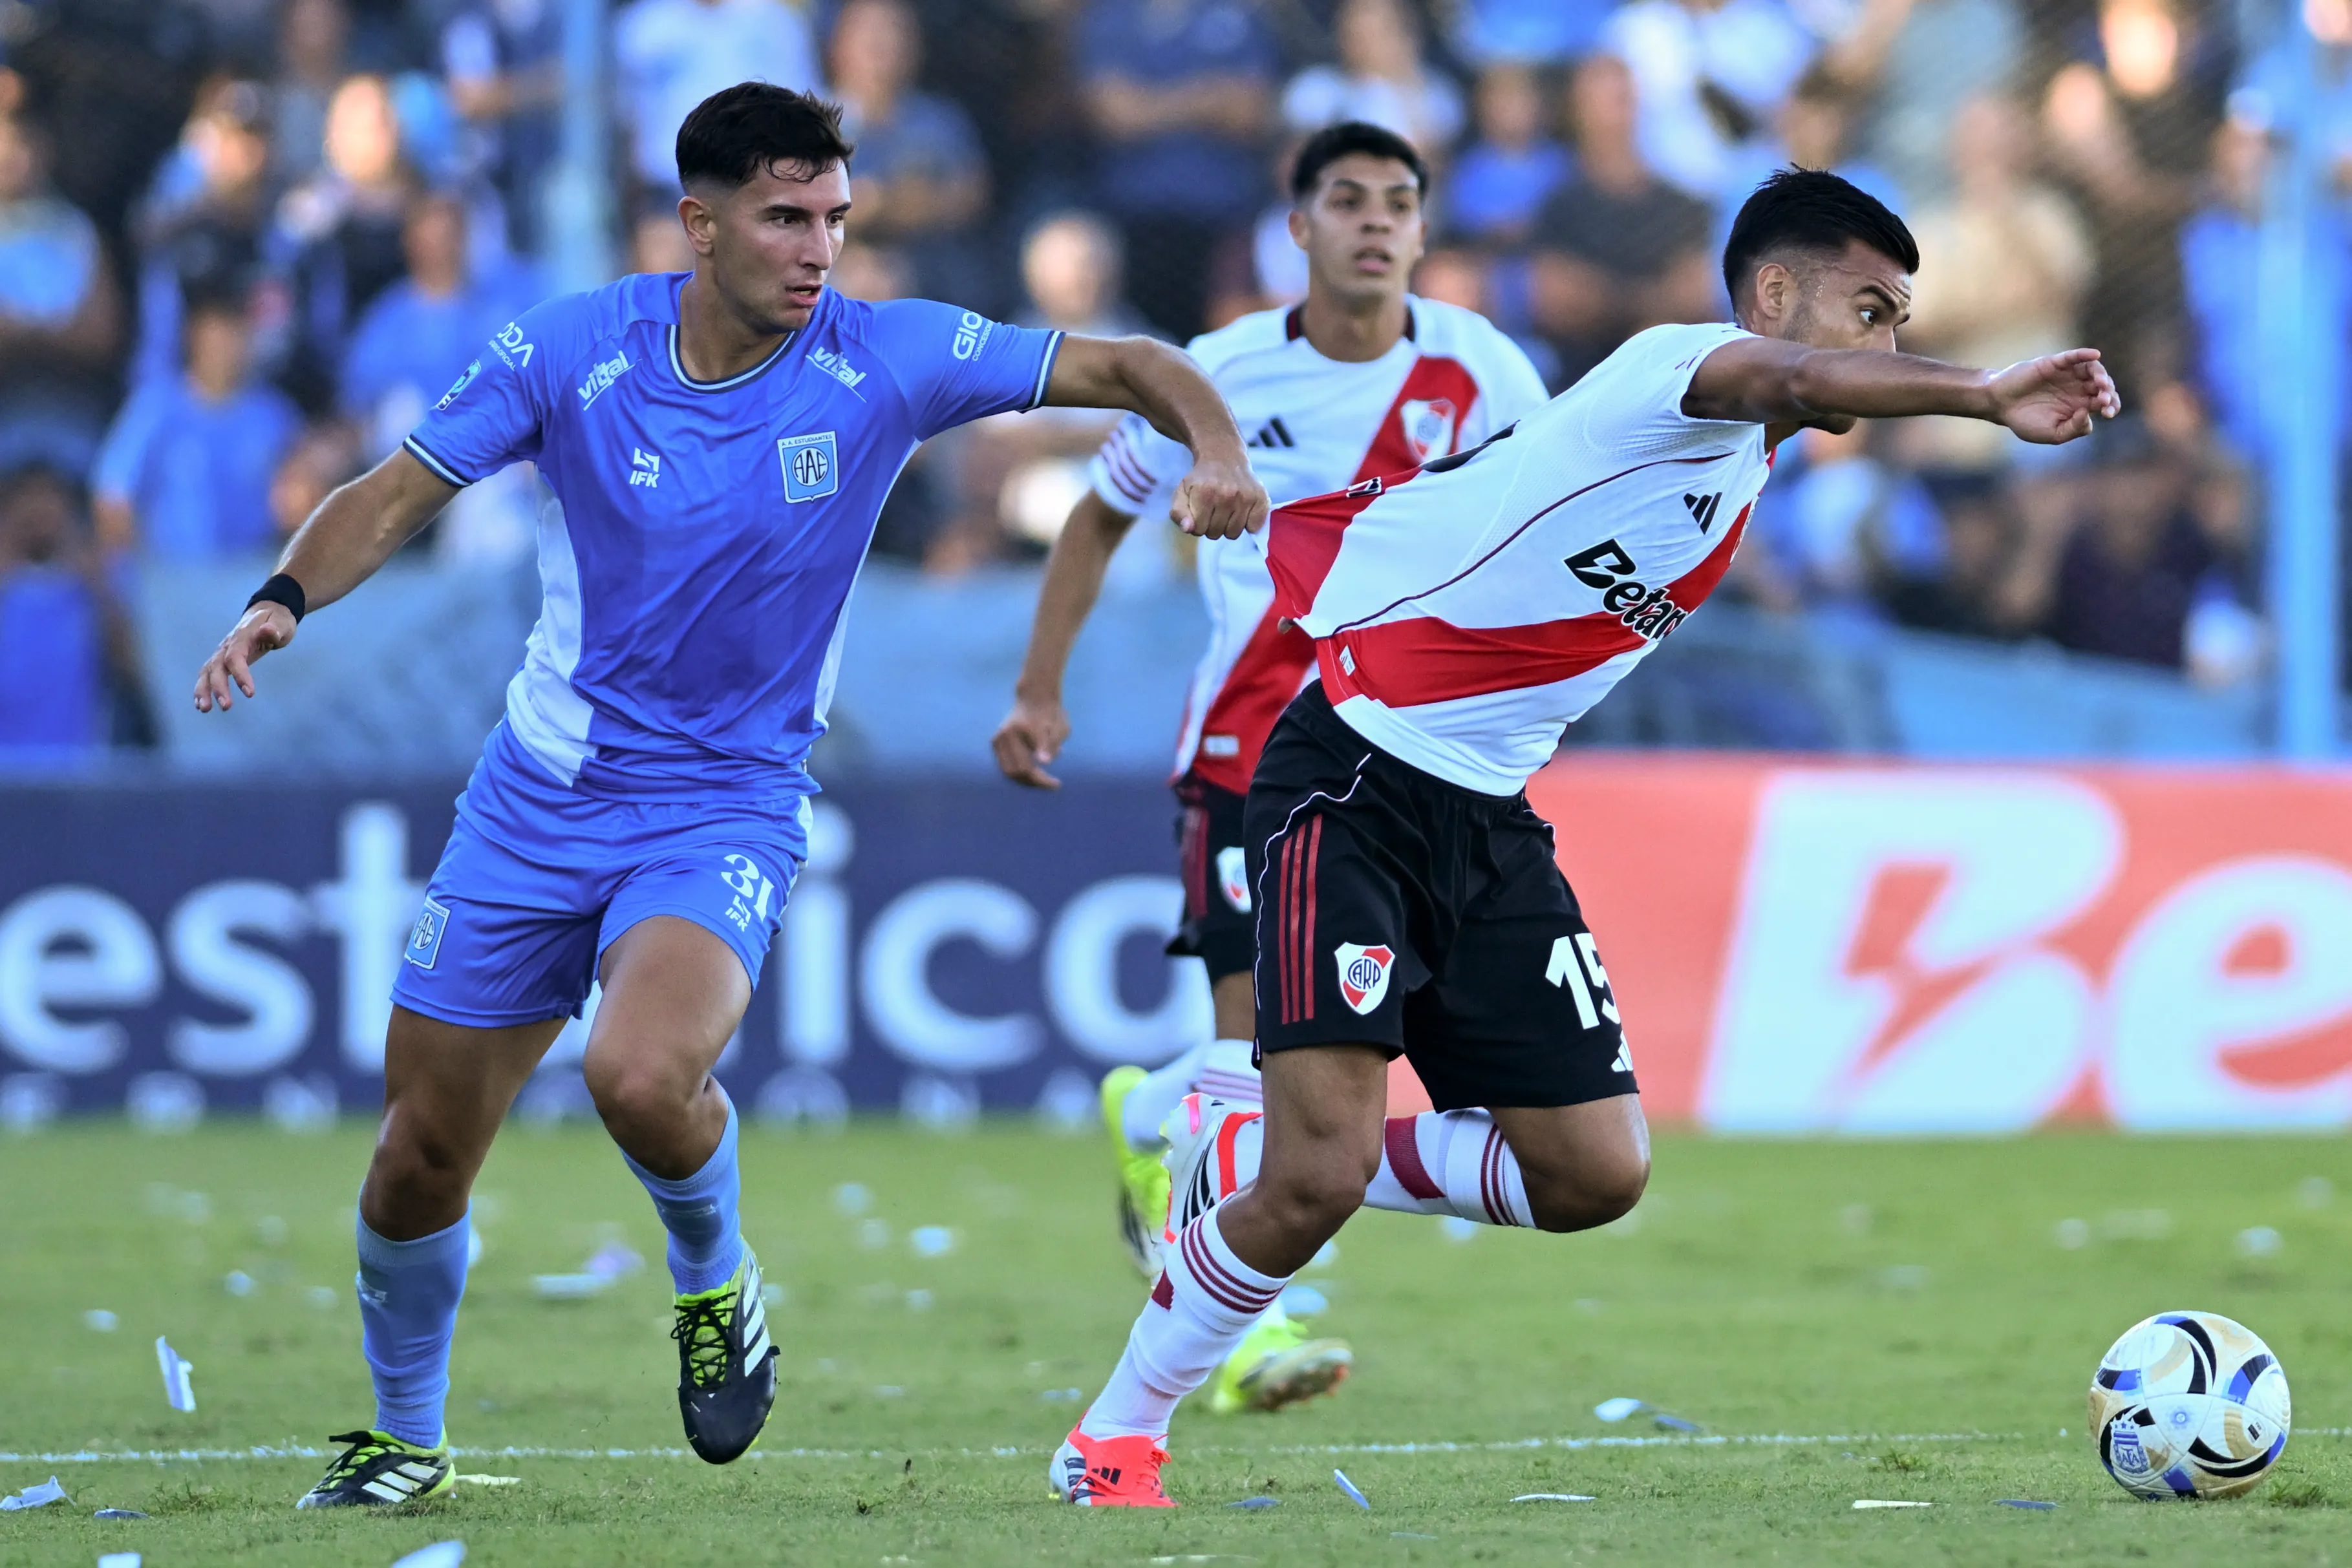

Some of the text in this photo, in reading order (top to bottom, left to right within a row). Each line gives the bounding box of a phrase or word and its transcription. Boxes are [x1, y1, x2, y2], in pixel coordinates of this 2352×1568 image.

[952, 312, 983, 360] GIO
[577, 350, 629, 401] vittal
[795, 434, 833, 445] ESTUDIANTES
[629, 470, 660, 488] IFK
[720, 854, 775, 923] 31
[725, 907, 748, 932] IFK
[1545, 932, 1621, 1030] 15
